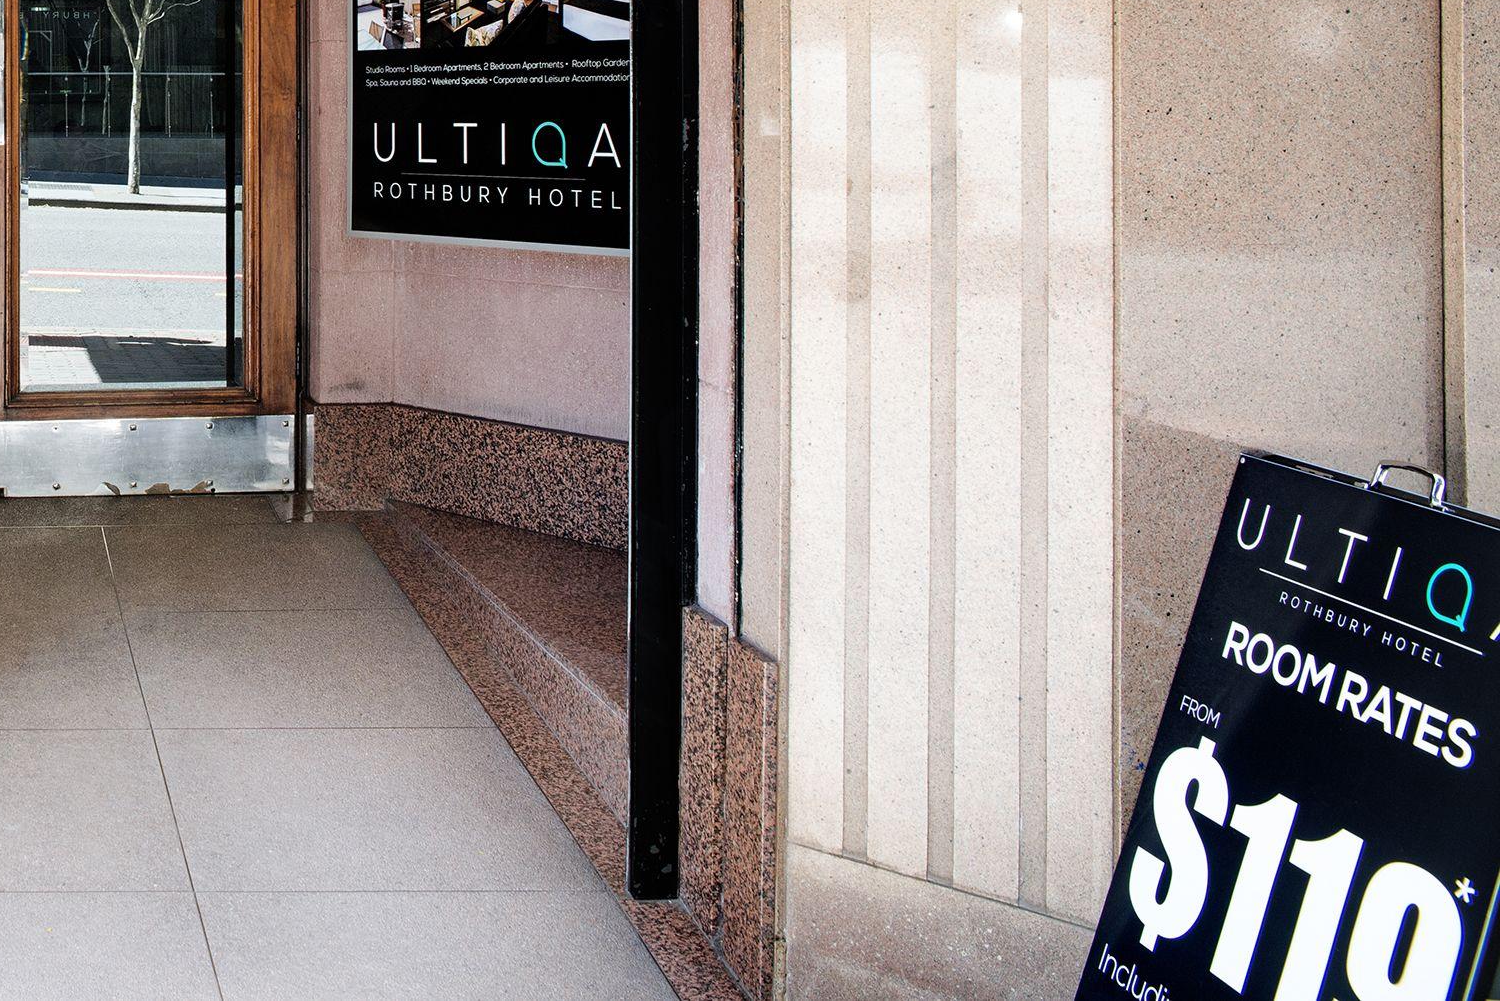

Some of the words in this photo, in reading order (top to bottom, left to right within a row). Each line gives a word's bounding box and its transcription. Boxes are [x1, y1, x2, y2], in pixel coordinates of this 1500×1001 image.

[366, 66, 384, 74] Studio
[414, 64, 442, 73] Bedroom
[443, 63, 482, 73] Apartments,
[490, 62, 521, 71] Bedroom
[522, 61, 564, 71] Apartments
[572, 59, 601, 69] Rooftop
[413, 78, 426, 86] BBQ
[431, 77, 460, 85] Weekend
[461, 77, 488, 86] Specials
[493, 76, 527, 85] Corporate
[530, 75, 543, 83] and
[545, 75, 570, 83] Leisure
[374, 122, 621, 168] ULTIQA
[374, 182, 509, 203] ROTHBURY
[529, 189, 621, 209] HOTEL
[1236, 498, 1500, 640] ULTIQ
[1279, 591, 1370, 637] ROTHBURY
[1383, 631, 1443, 667] HOTEL
[1180, 695, 1220, 729] FROM
[1222, 620, 1336, 704] ROOM
[1336, 667, 1479, 769] RATES
[1098, 943, 1171, 1001] Includi
